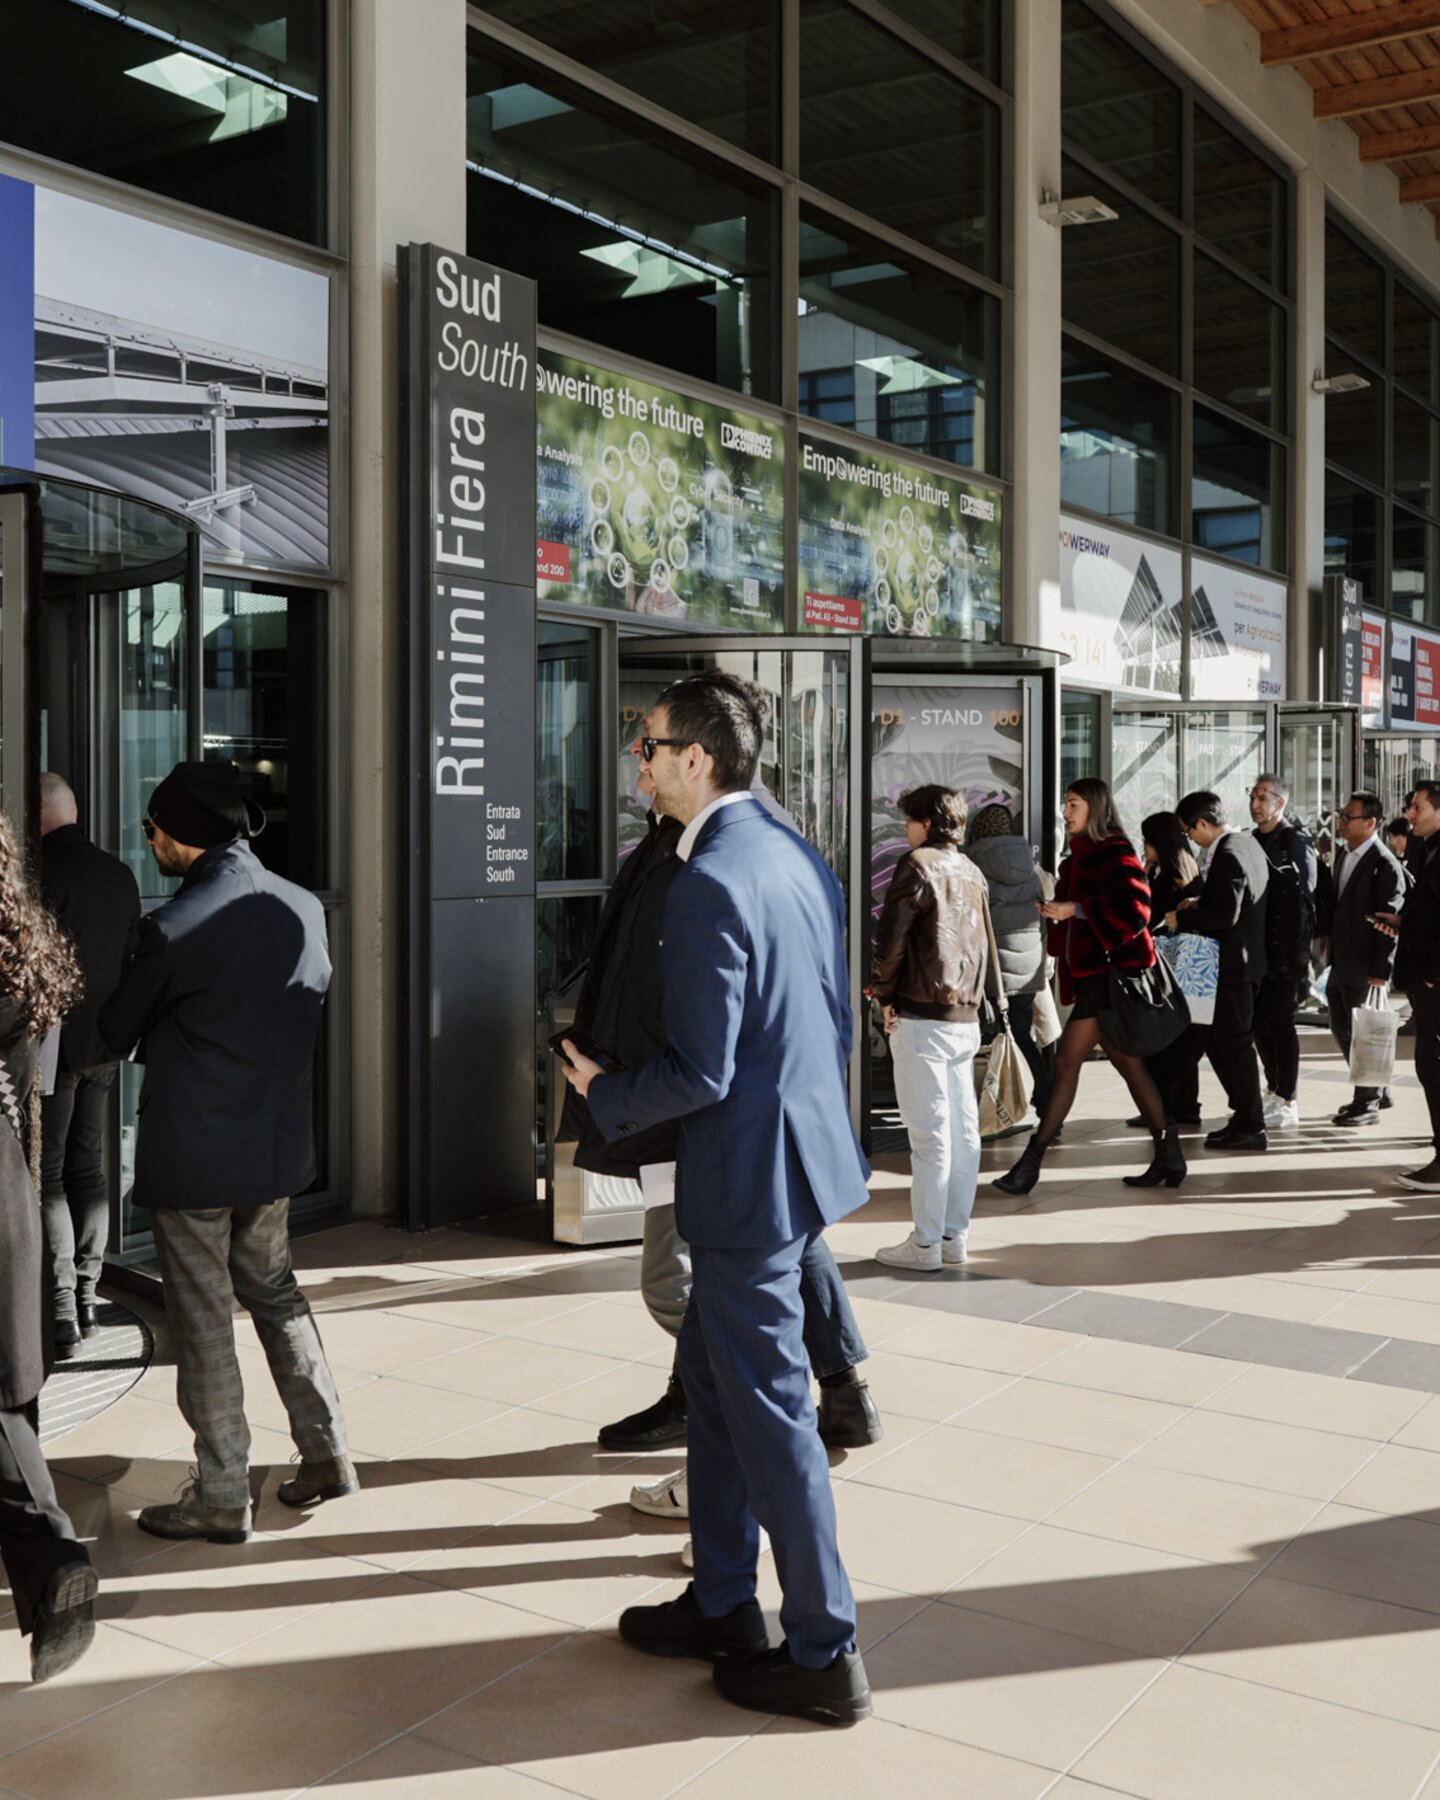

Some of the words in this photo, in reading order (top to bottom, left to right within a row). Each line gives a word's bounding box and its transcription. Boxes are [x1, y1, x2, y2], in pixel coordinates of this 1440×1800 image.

[436, 256, 501, 323] Sud
[438, 321, 527, 391] South
[617, 387, 648, 421] the
[651, 397, 704, 438] future
[544, 445, 583, 466] Analysis
[734, 440, 772, 459] CONTACT
[804, 445, 891, 498] Empowering
[893, 472, 913, 498] the
[914, 477, 950, 508] future
[436, 407, 486, 568] Fiera
[550, 563, 565, 576] 200
[1234, 622, 1246, 636] per
[436, 585, 485, 796] Rimini
[920, 709, 983, 726] STAND
[991, 709, 1021, 727] 100
[486, 802, 521, 819] Entrata
[486, 823, 506, 840] Sud
[486, 844, 528, 861] Entrance
[486, 865, 516, 883] South
